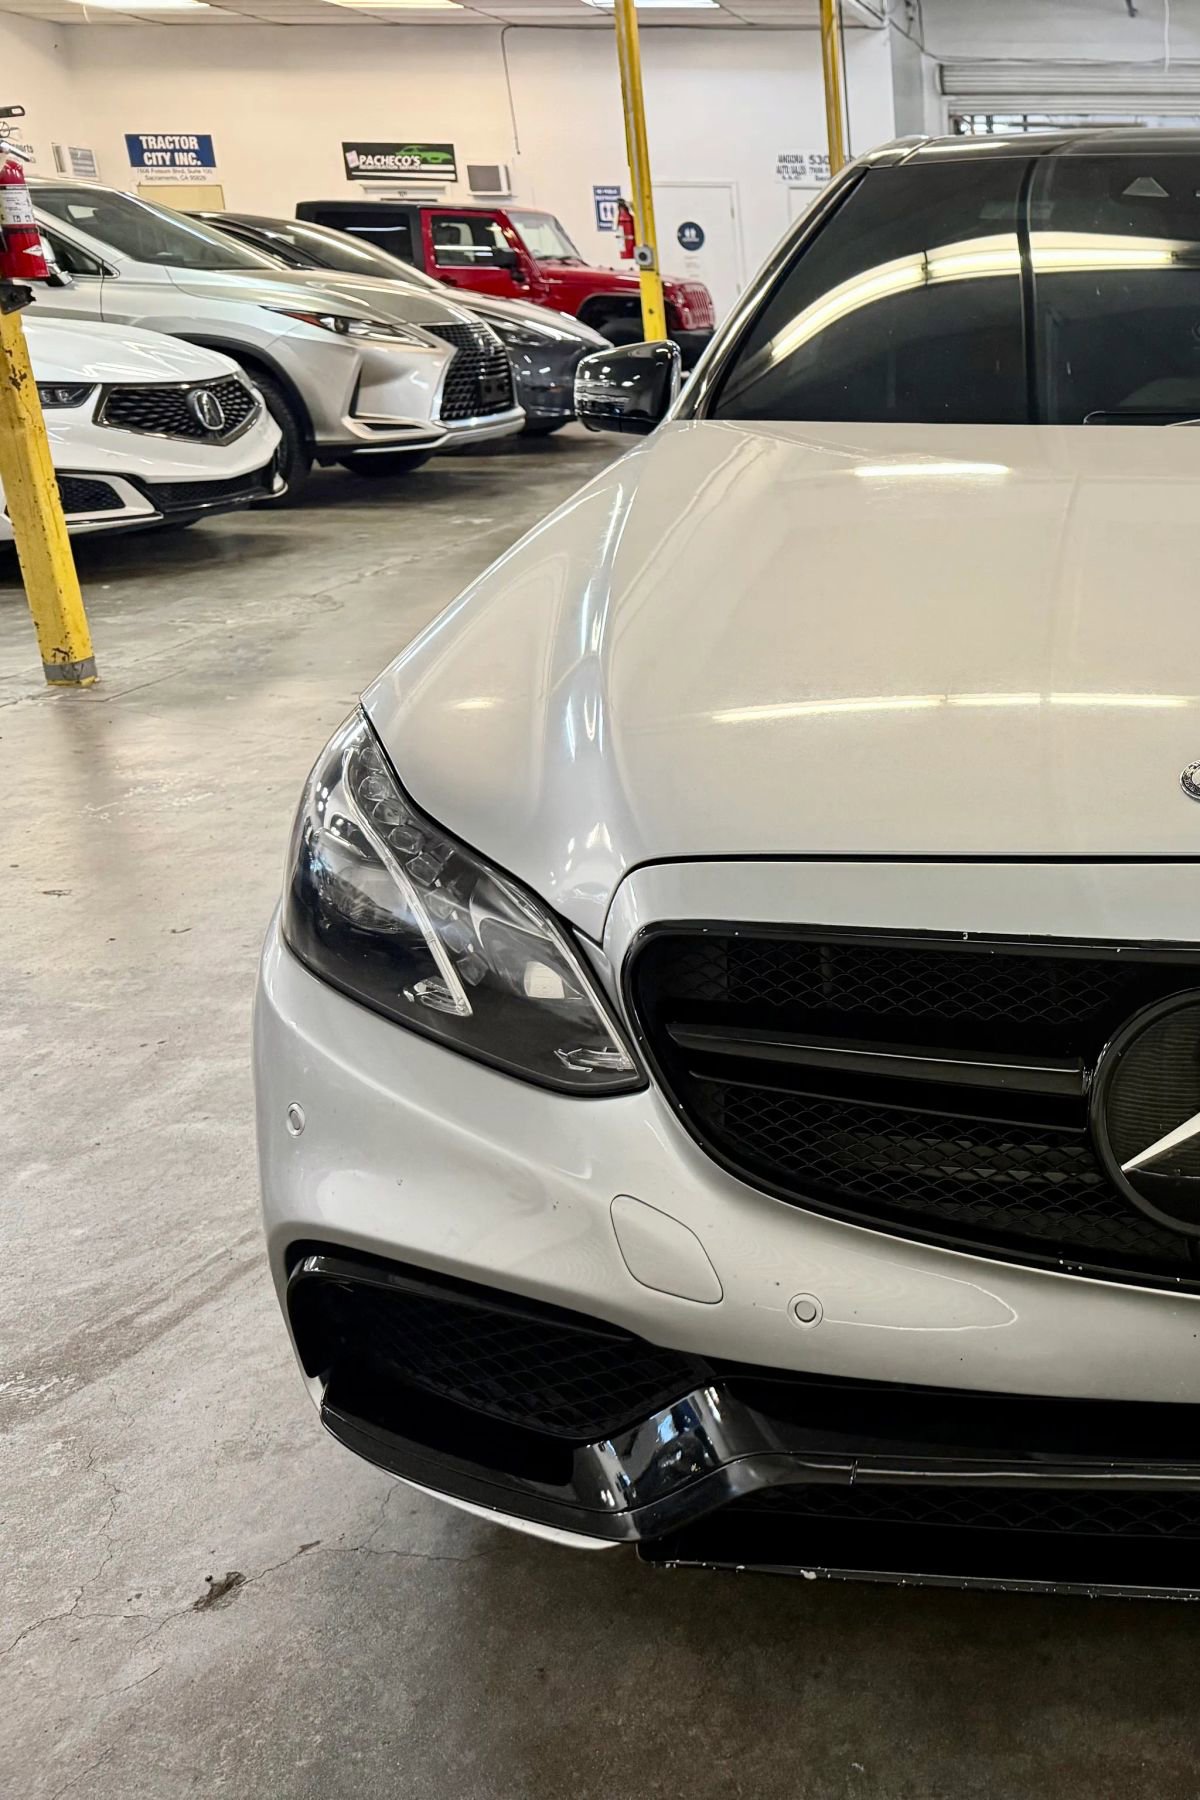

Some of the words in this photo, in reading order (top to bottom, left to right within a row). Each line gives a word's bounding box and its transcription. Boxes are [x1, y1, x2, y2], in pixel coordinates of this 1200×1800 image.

[138, 135, 200, 150] TRACTOR
[143, 151, 171, 166] CITY
[174, 151, 202, 166] INC.
[359, 154, 421, 167] PACHECO'S
